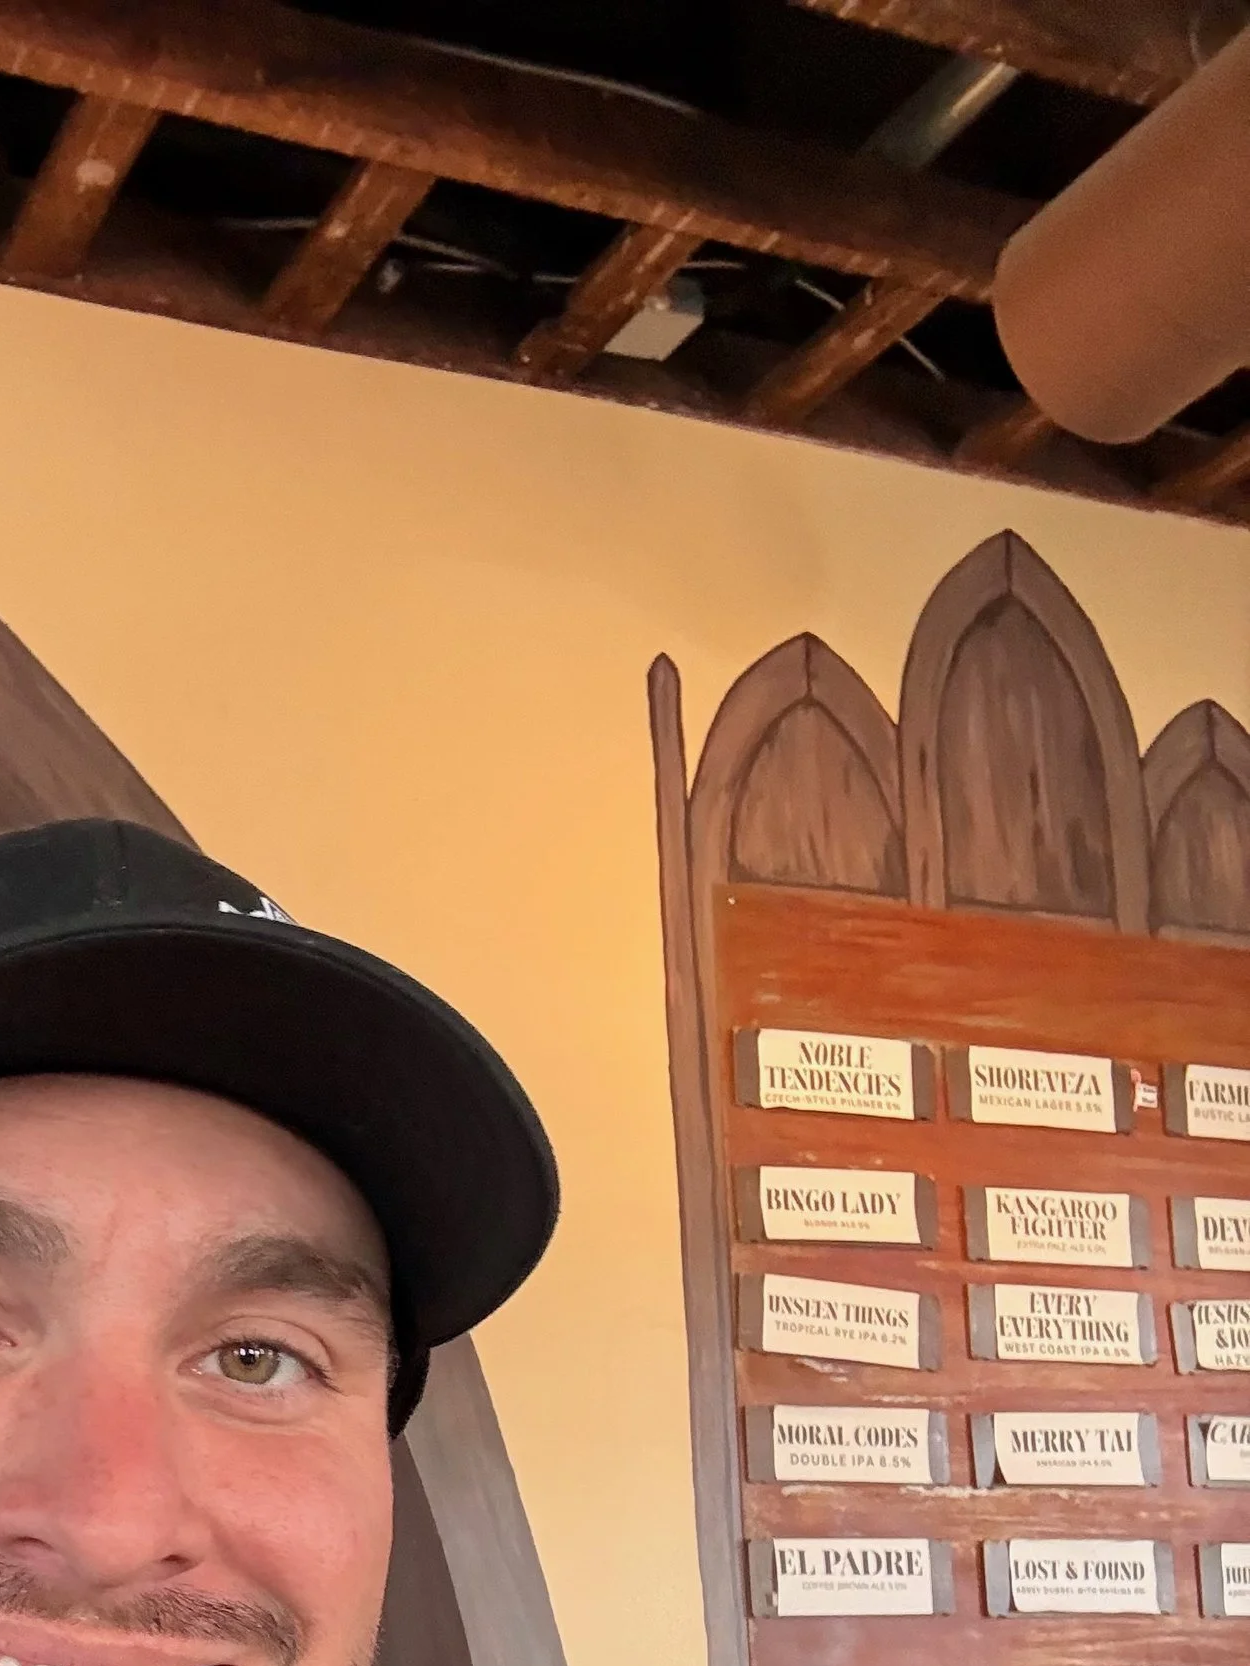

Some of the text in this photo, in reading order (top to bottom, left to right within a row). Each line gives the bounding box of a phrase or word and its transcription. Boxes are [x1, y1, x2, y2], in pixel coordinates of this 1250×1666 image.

[799, 1041, 872, 1070] NOBLE
[764, 1065, 902, 1097] TENDENCIES
[974, 1063, 1102, 1096] SHOREVEZA
[978, 1094, 1032, 1109] MEXICAN
[1035, 1098, 1072, 1113] LAGER
[766, 1187, 901, 1215] BINGO LADY
[996, 1193, 1117, 1221] KANGAROO
[1011, 1216, 1107, 1241] FIGHTER
[1202, 1214, 1250, 1243] DEV
[769, 1294, 909, 1328] UNSEEN THINGS
[1029, 1291, 1098, 1317] EVERY
[774, 1320, 830, 1337] TROPICAL
[833, 1327, 855, 1340] RYE
[858, 1330, 878, 1342] IPA
[999, 1315, 1129, 1343] EVERYTHING
[1004, 1342, 1035, 1354] WEST
[1039, 1343, 1077, 1355] COAST
[1080, 1346, 1100, 1356] IPA
[777, 1423, 918, 1448] MORAL CODES
[1011, 1428, 1132, 1453] MERRY TAI
[790, 1453, 847, 1467] DOUBLE
[851, 1454, 875, 1467] IPA
[778, 1547, 923, 1577] EL PADRE
[1013, 1558, 1145, 1582] LOST & FOUND
